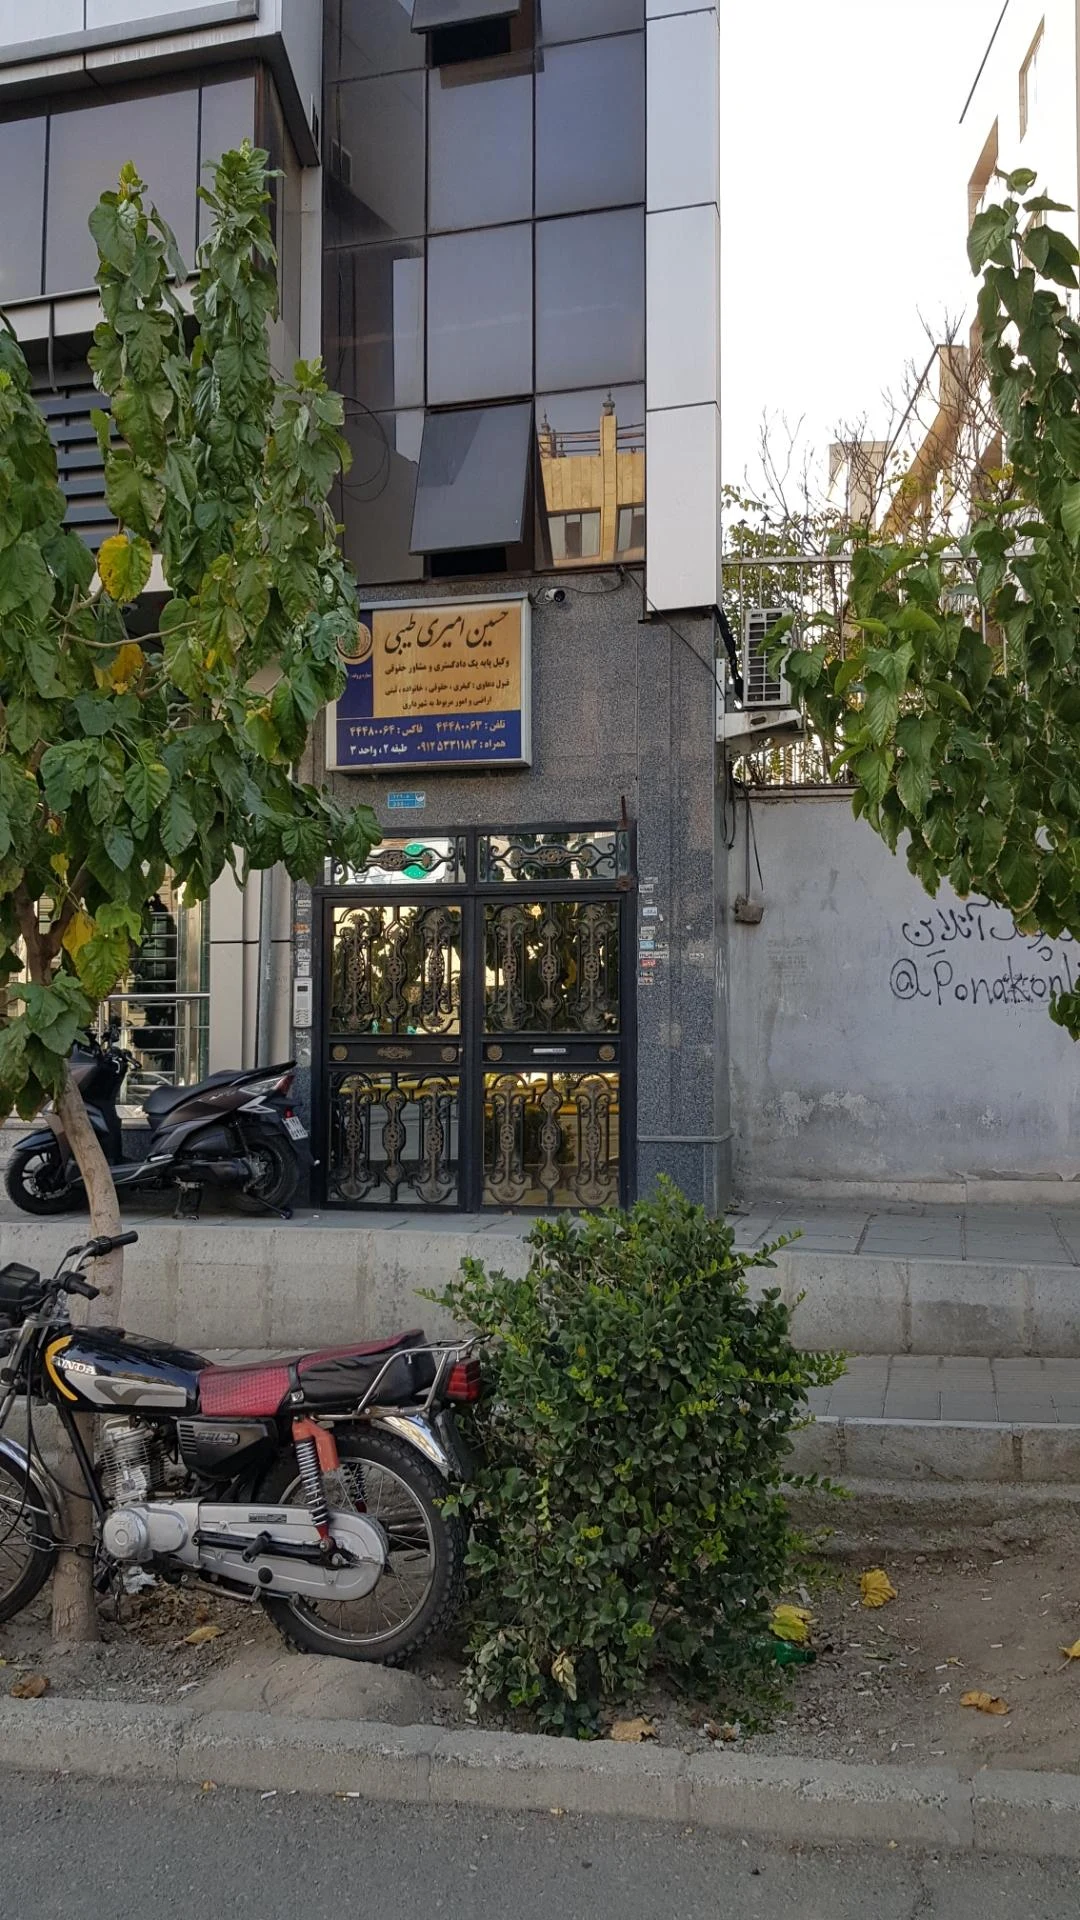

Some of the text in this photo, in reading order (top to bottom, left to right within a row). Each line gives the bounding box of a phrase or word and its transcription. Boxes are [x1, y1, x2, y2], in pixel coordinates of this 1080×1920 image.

[385, 613, 416, 655] طیبی
[417, 615, 465, 649] امیری
[466, 611, 509, 648] حسین
[409, 662, 426, 673] مشاور
[434, 659, 466, 672] دادگستری
[468, 659, 478, 669] یک
[480, 658, 491, 669] پایه
[493, 657, 510, 668] وکیل
[385, 665, 406, 675] حقوقی
[496, 679, 510, 689] قبول
[402, 699, 427, 710] شهرداری
[455, 697, 467, 707] امور
[358, 745, 377, 757] واحد
[390, 743, 408, 755] طبقه
